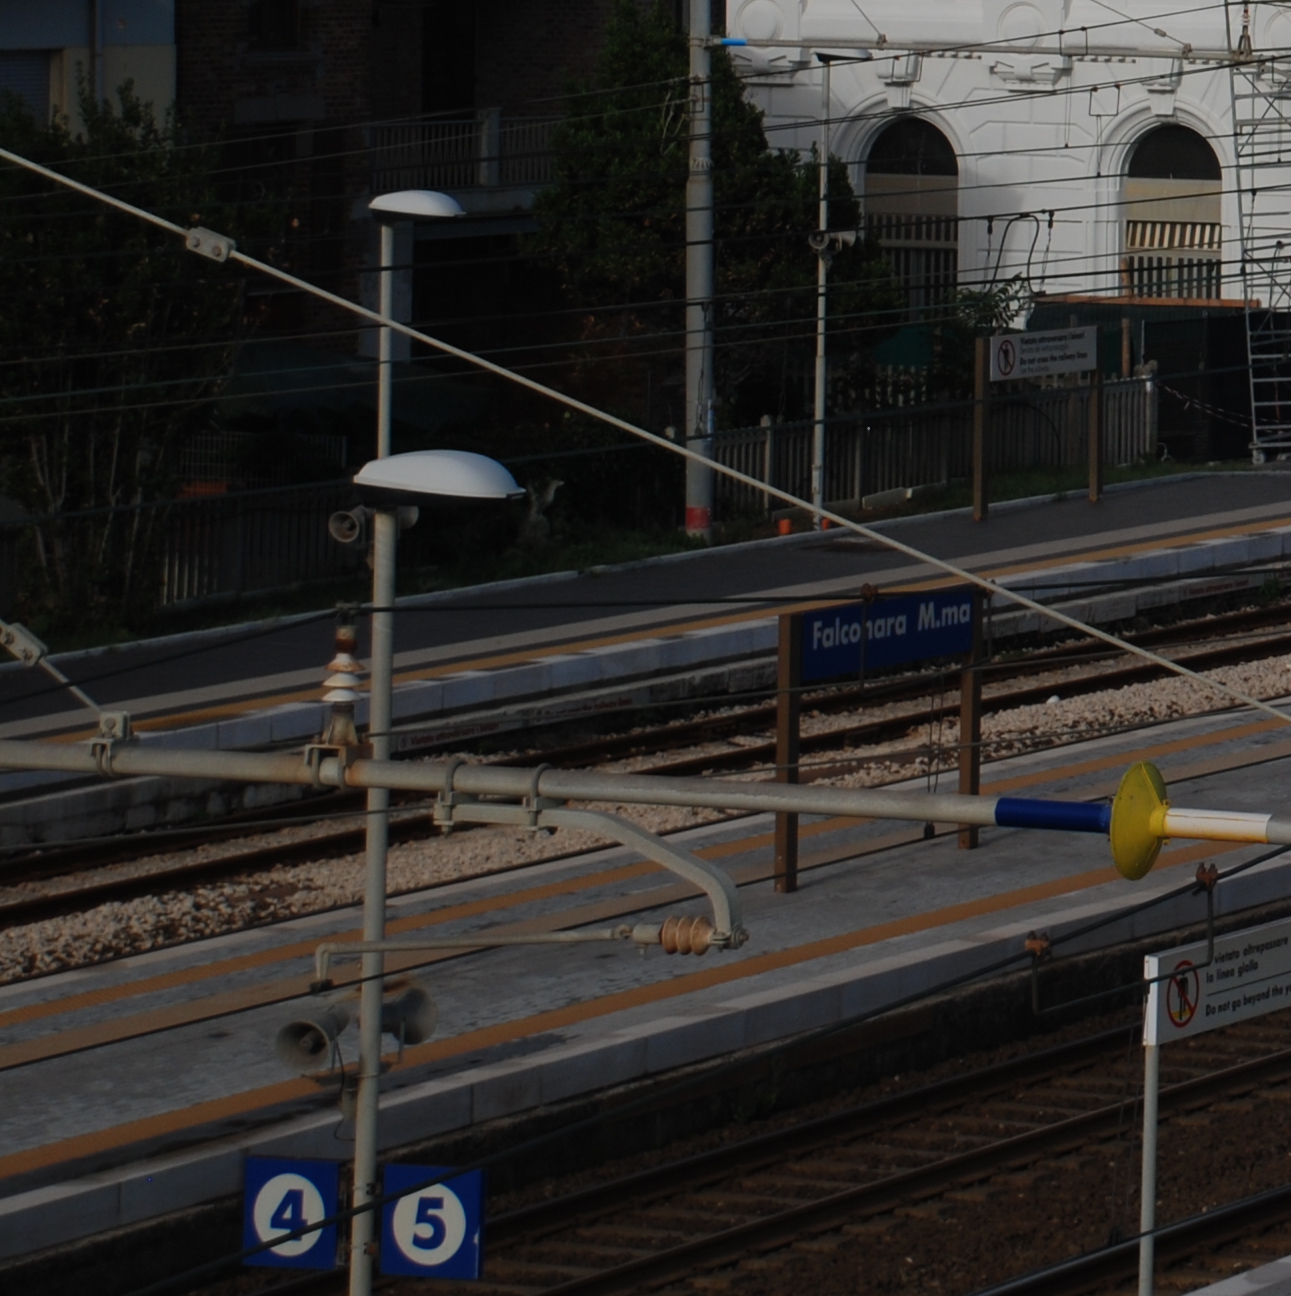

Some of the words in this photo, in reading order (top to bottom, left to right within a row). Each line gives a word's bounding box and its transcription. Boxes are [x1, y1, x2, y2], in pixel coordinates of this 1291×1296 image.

[812, 614, 907, 650] Falconara
[917, 602, 971, 632] M.ma
[1214, 949, 1240, 964] vietato
[1243, 936, 1289, 957] oltrepassare
[1206, 971, 1214, 983] la
[1216, 967, 1235, 980] linea
[1237, 958, 1258, 978] gialla
[1205, 1004, 1216, 1017] Do
[1217, 1001, 1230, 1011] not
[1231, 999, 1241, 1012] go
[1243, 987, 1271, 1006] beyond
[1272, 985, 1283, 997] the
[270, 1189, 308, 1241] 4
[413, 1197, 446, 1250] 5
